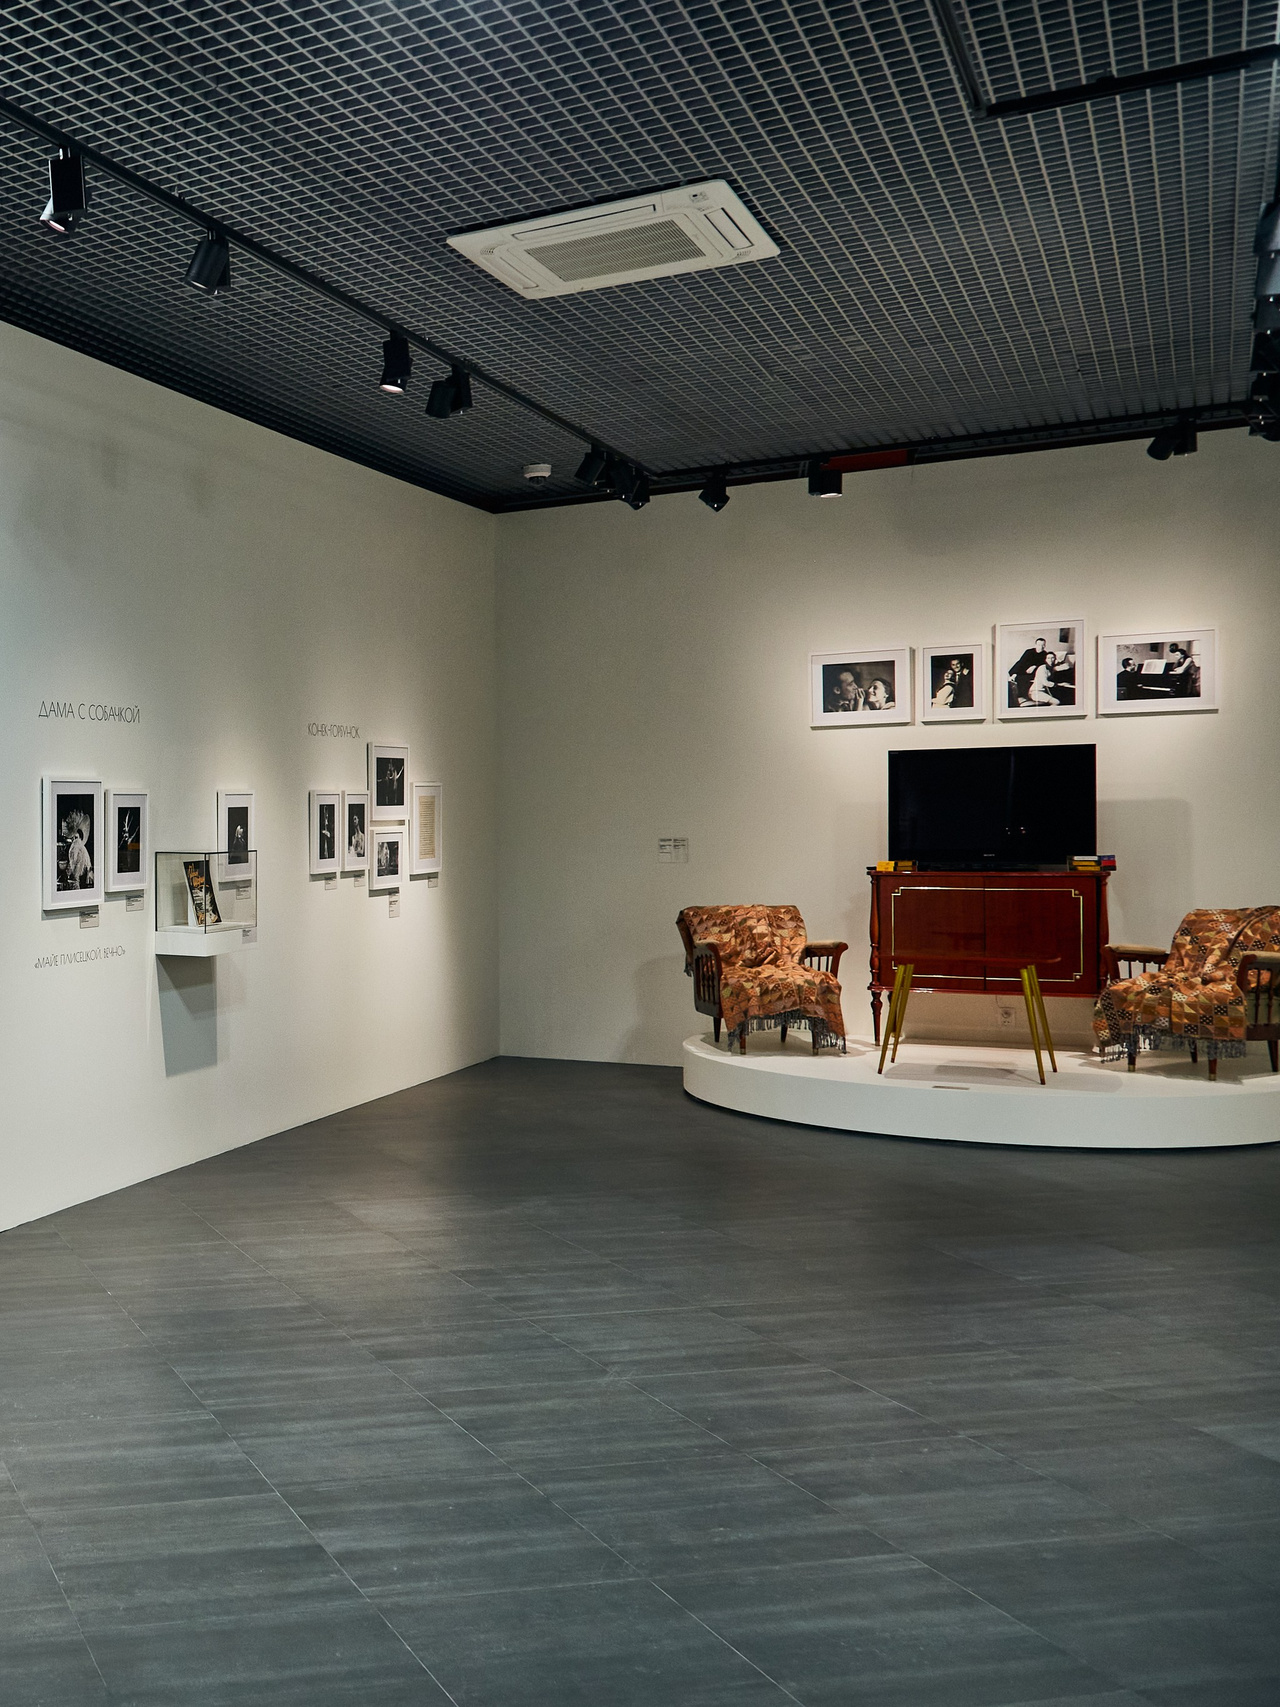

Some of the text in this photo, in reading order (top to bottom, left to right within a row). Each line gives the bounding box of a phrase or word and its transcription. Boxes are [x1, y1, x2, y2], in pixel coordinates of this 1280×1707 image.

[38, 700, 141, 724] ДАМА С СОБАЧКОЙ
